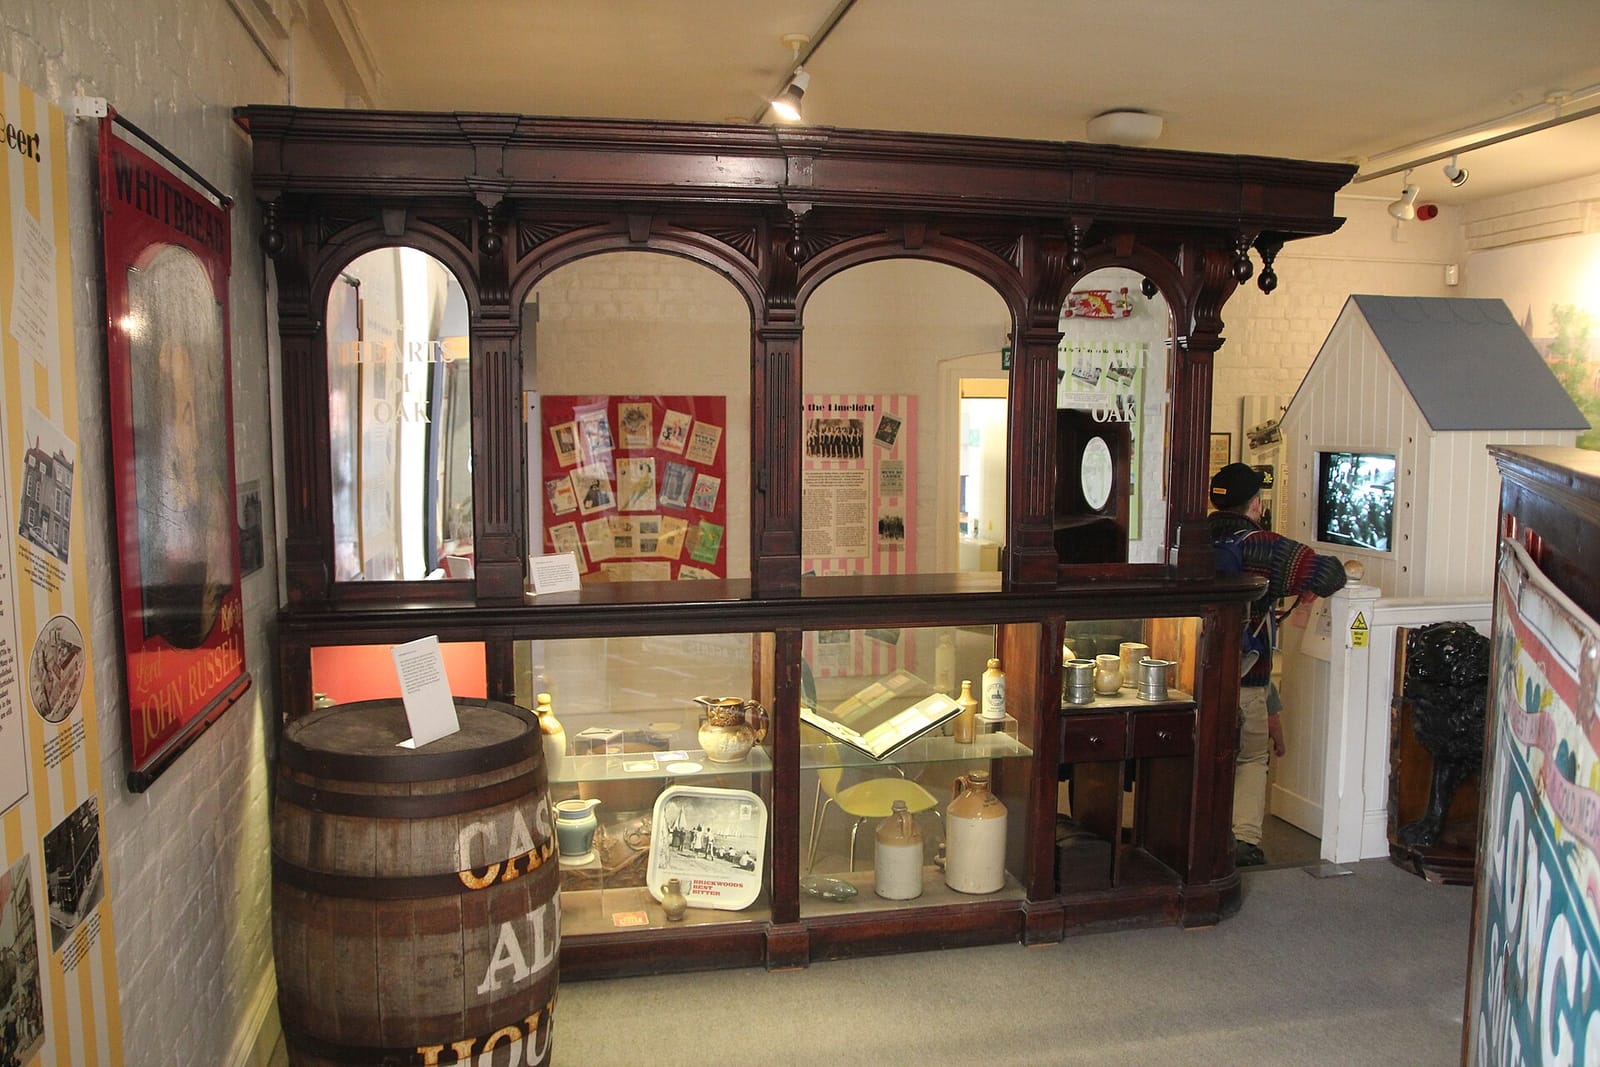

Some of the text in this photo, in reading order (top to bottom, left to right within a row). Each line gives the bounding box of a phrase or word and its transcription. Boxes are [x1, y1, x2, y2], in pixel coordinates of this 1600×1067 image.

[112, 149, 225, 256] WHITBREAD
[357, 340, 456, 364] HEARTS
[373, 400, 432, 424] OAK
[808, 403, 825, 412] the
[828, 402, 875, 412] Limelight
[1091, 402, 1137, 424] OAK
[136, 644, 161, 694] Lord
[140, 674, 184, 757] JOHN
[187, 633, 243, 706] RUSSELL
[692, 879, 744, 888] BRICKWOODS
